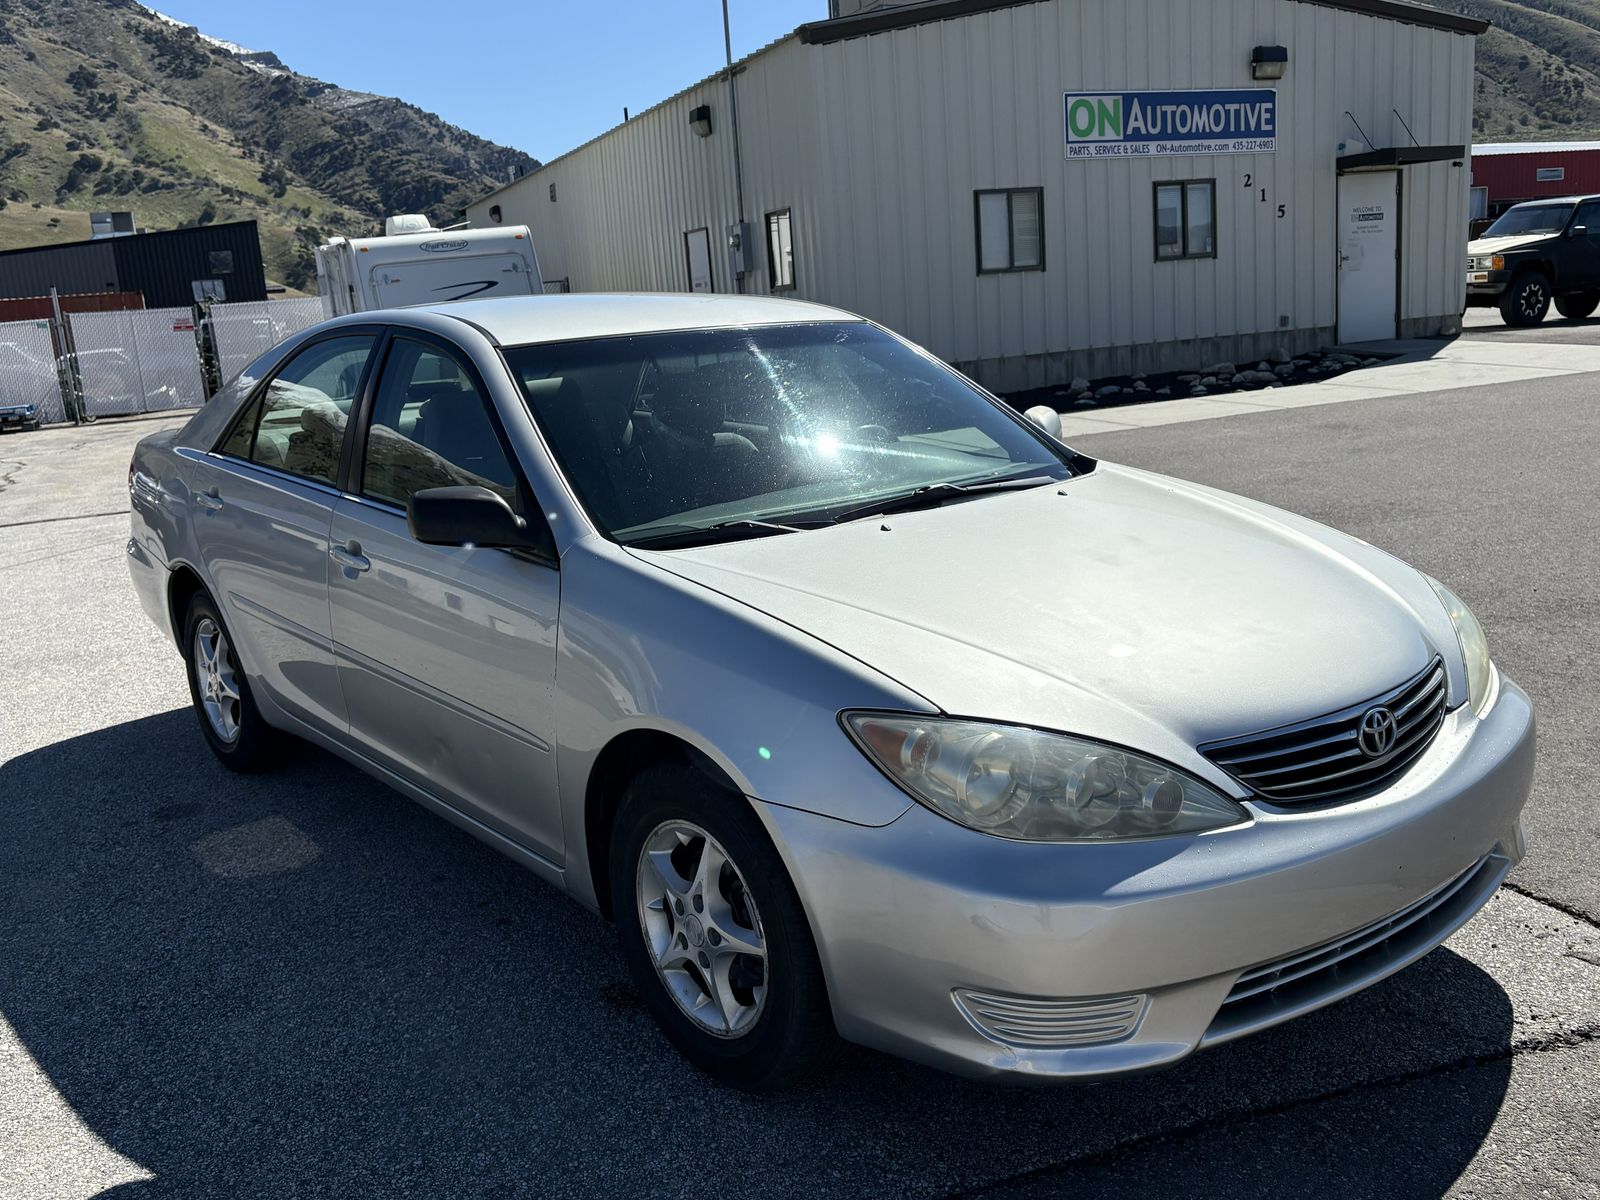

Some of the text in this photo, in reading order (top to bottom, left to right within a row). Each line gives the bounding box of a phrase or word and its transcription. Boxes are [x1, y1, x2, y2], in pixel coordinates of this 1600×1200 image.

[1069, 97, 1273, 138] ON AUTOMOTIVE
[1069, 140, 1273, 157] PARTS, SERVICE & SALES ON-Automotive.com 435-227-6903
